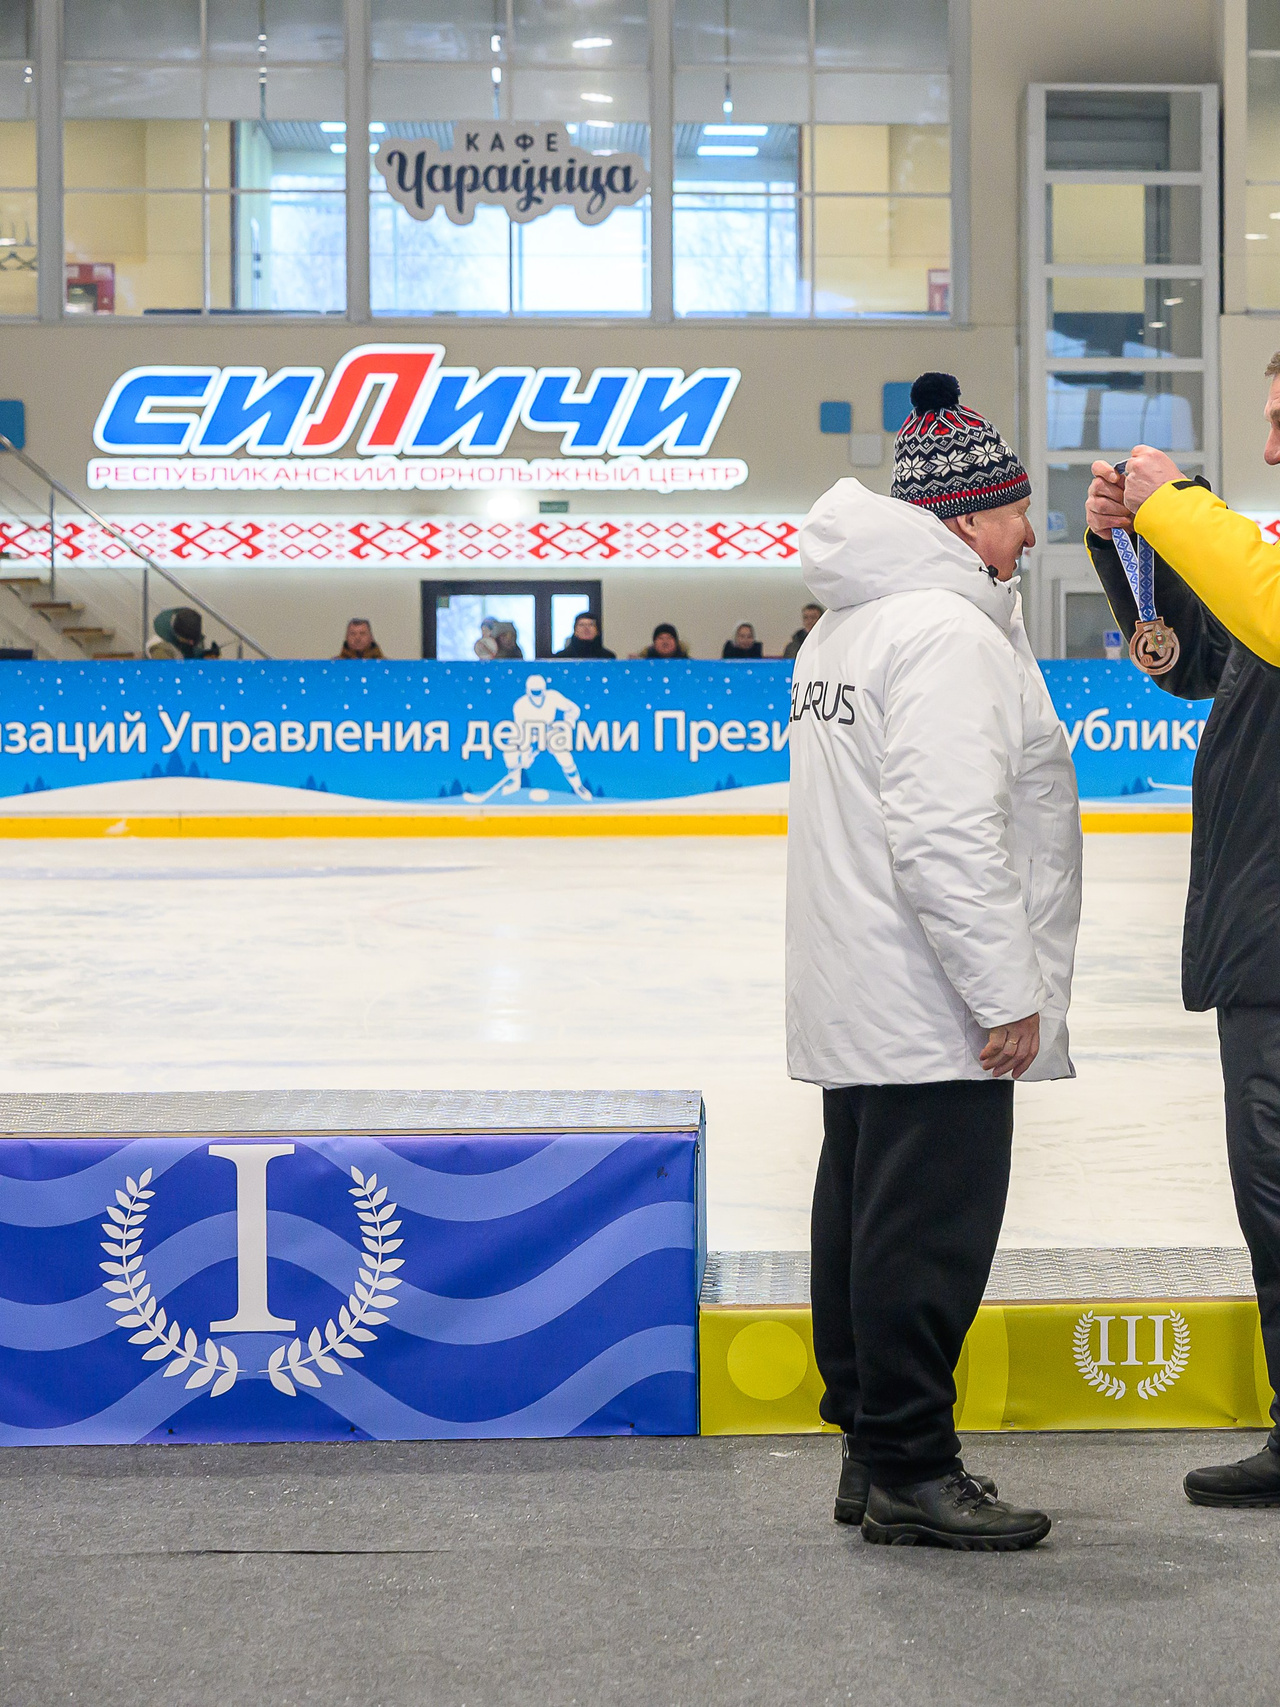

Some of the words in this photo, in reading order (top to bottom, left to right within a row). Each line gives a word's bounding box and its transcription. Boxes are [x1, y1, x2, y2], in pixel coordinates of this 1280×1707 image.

[466, 132, 559, 152] КАФЕ
[386, 150, 639, 215] Чараўніца
[95, 463, 397, 483] РЕСПУБЛИКАНСКИЙ
[404, 463, 641, 483] ГОРНОЛЫЖНЫЙ
[650, 466, 740, 486] ЦЕНТР
[0, 710, 148, 762] заций
[157, 710, 451, 764] Управления
[461, 718, 640, 761] делами
[1060, 707, 1207, 755] ублик
[207, 1143, 296, 1333] I
[1092, 1314, 1171, 1366] III
